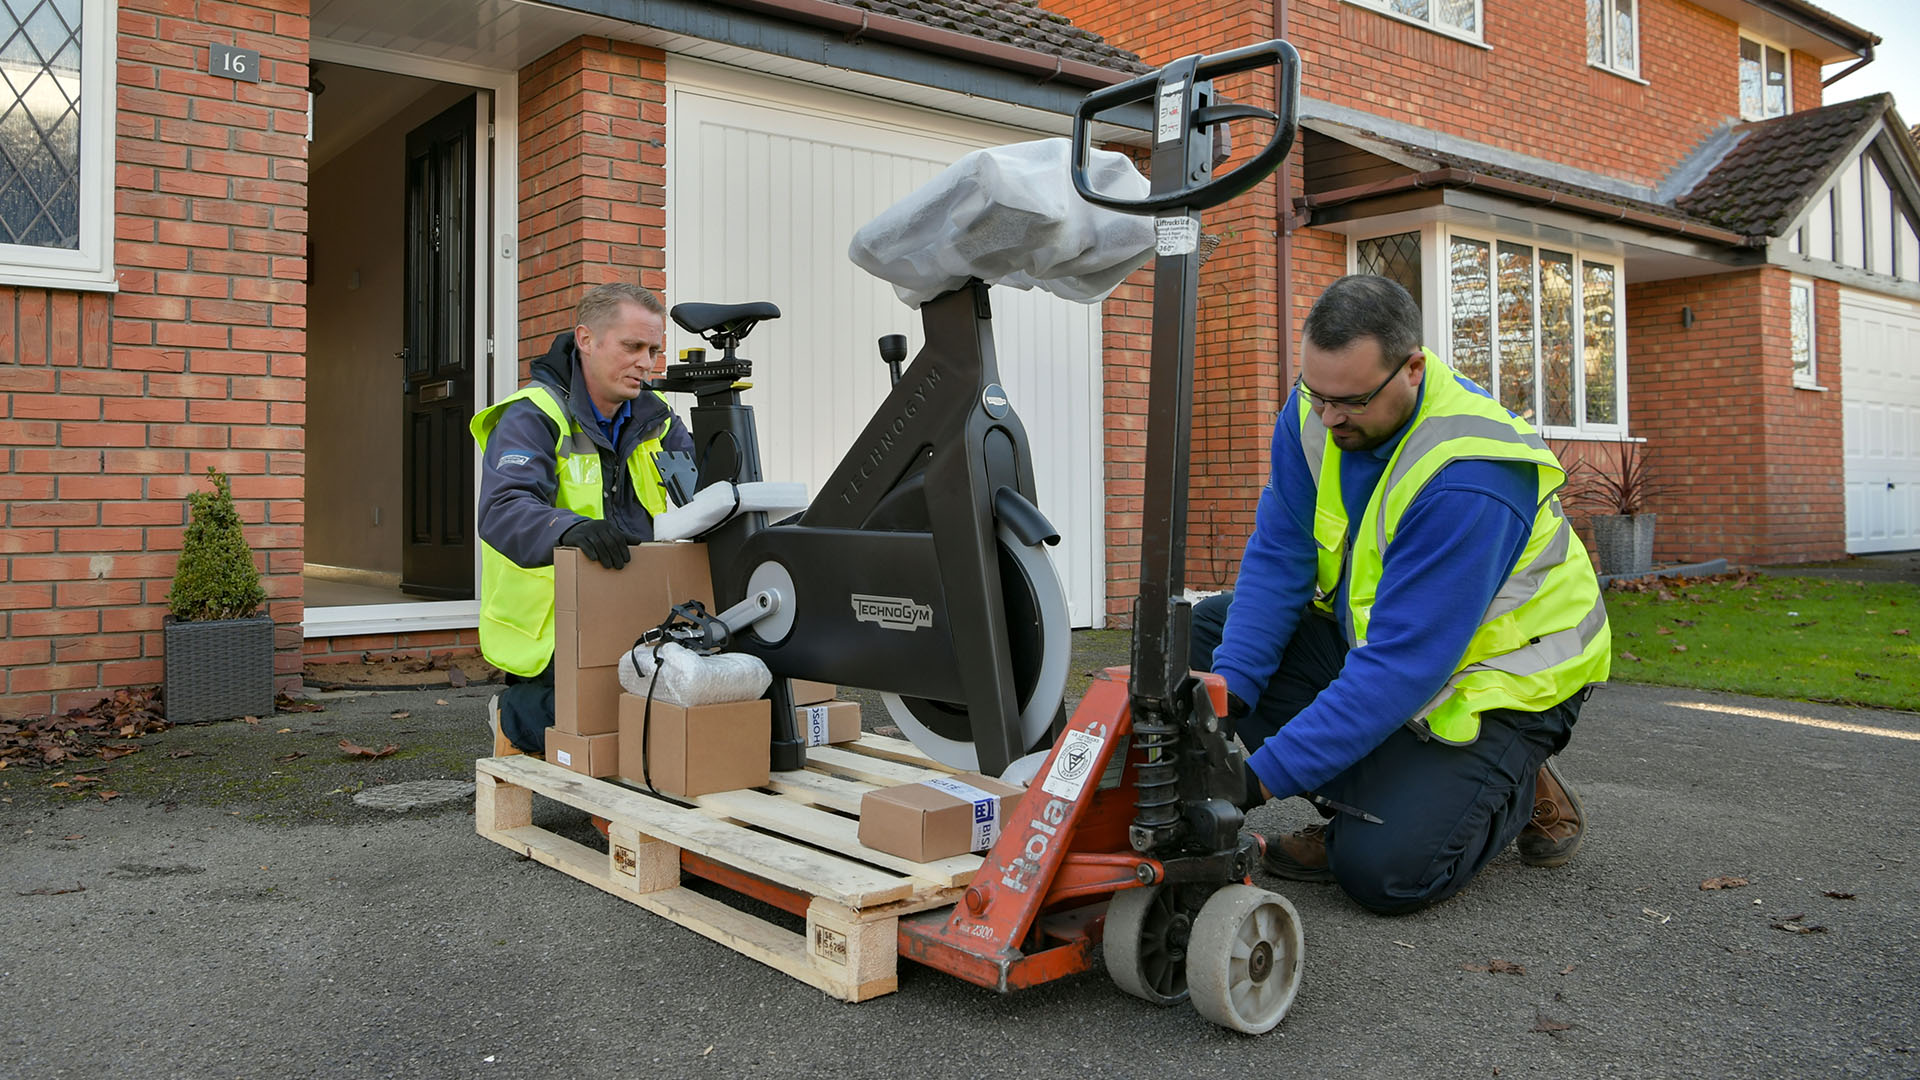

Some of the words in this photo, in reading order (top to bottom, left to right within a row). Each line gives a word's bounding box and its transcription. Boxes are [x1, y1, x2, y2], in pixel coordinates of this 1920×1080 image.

[223, 52, 246, 73] 16
[840, 366, 942, 505] TECHNOGYM
[971, 924, 995, 940] 2300
